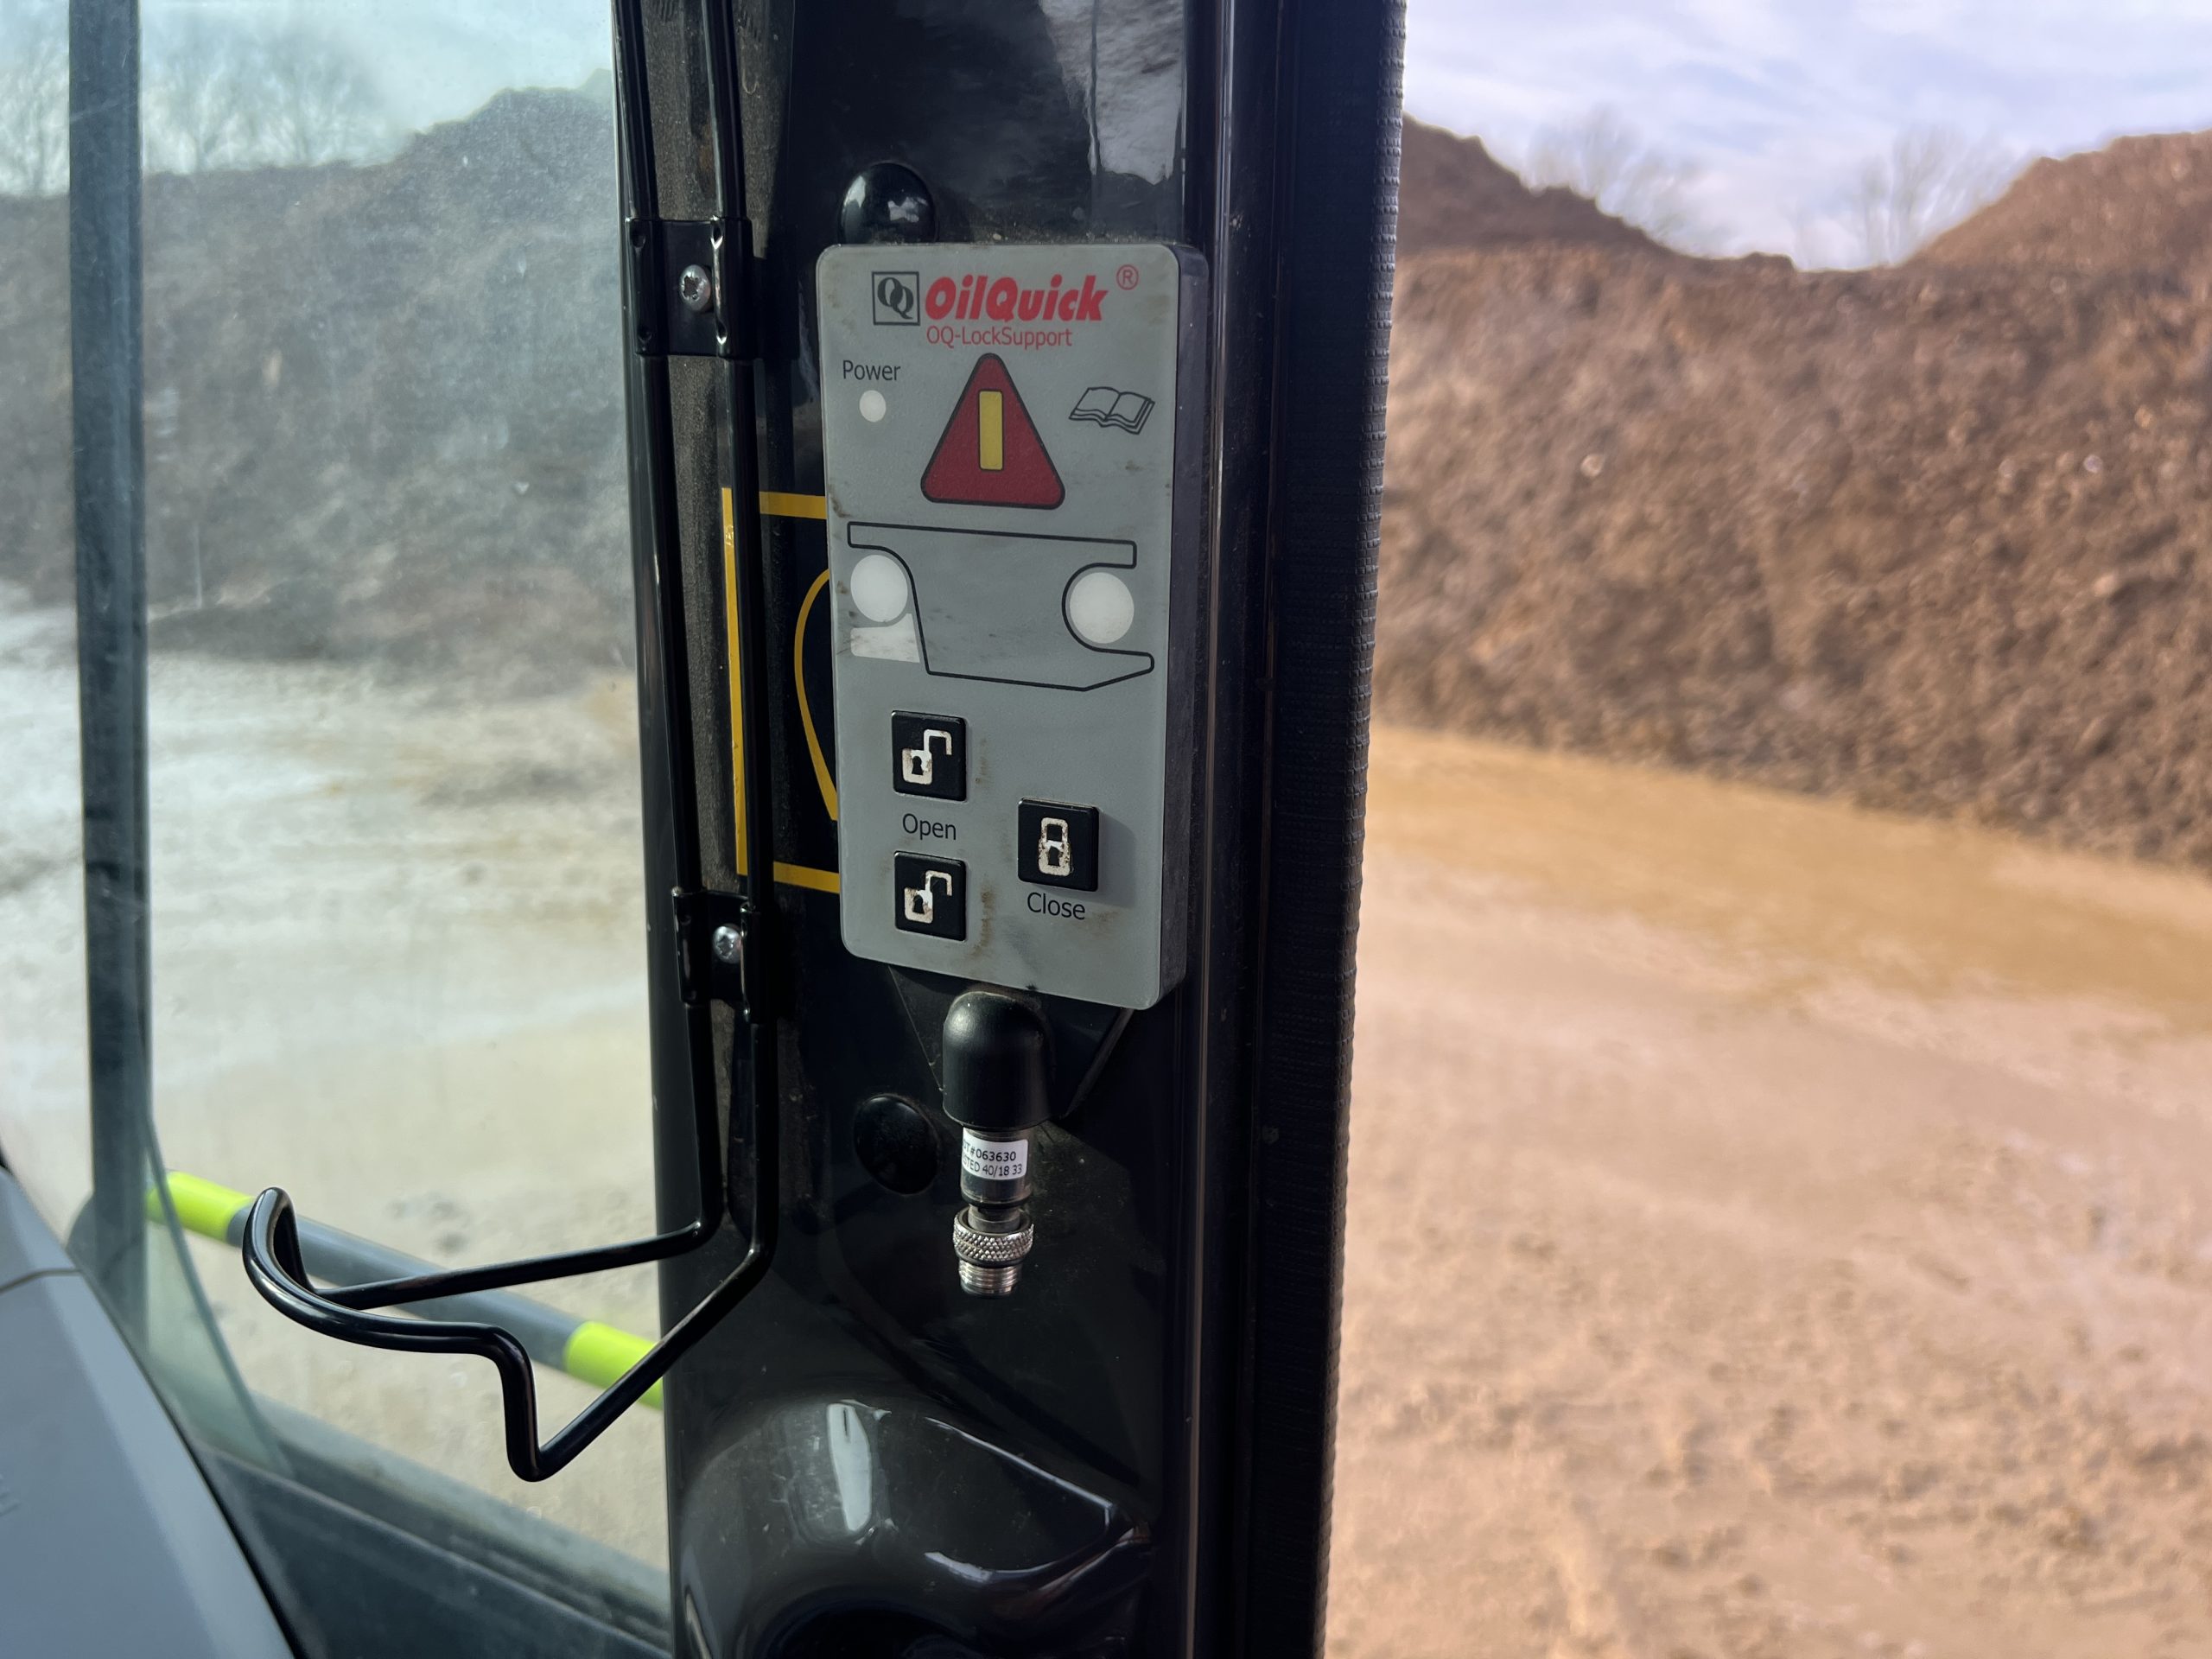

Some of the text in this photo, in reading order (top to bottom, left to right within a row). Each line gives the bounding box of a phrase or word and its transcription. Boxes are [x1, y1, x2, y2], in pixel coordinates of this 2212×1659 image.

[926, 325, 1072, 349] OQ-LockSupport
[842, 360, 900, 381] Power
[902, 813, 957, 840] Open
[1027, 892, 1086, 920] Close
[982, 1164, 1010, 1178] 40/18
[1012, 1163, 1023, 1175] 33
